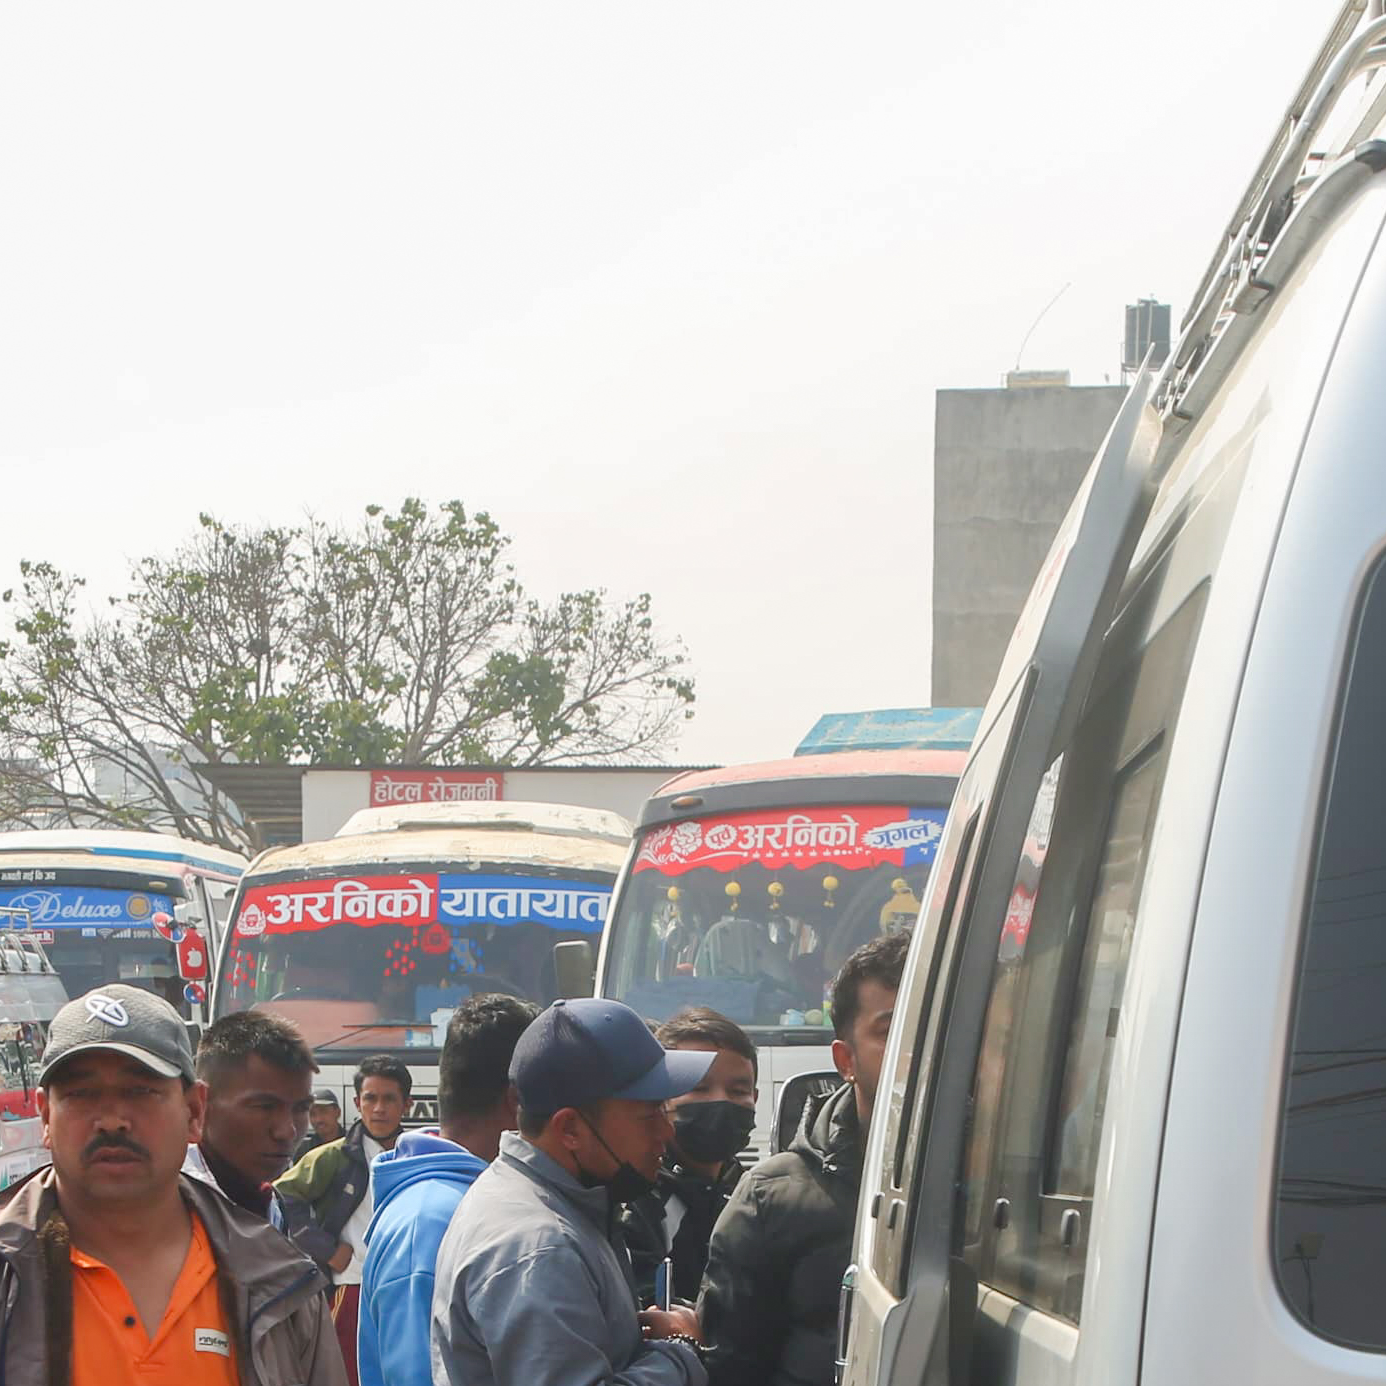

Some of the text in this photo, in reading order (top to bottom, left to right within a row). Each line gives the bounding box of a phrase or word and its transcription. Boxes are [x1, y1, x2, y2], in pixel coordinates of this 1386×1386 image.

[373, 776, 423, 802] होटल
[738, 814, 859, 850] अरनिको
[872, 822, 930, 846] जुगल
[8, 890, 122, 921] Deluxe
[267, 879, 612, 924] अरनिको यातायात
